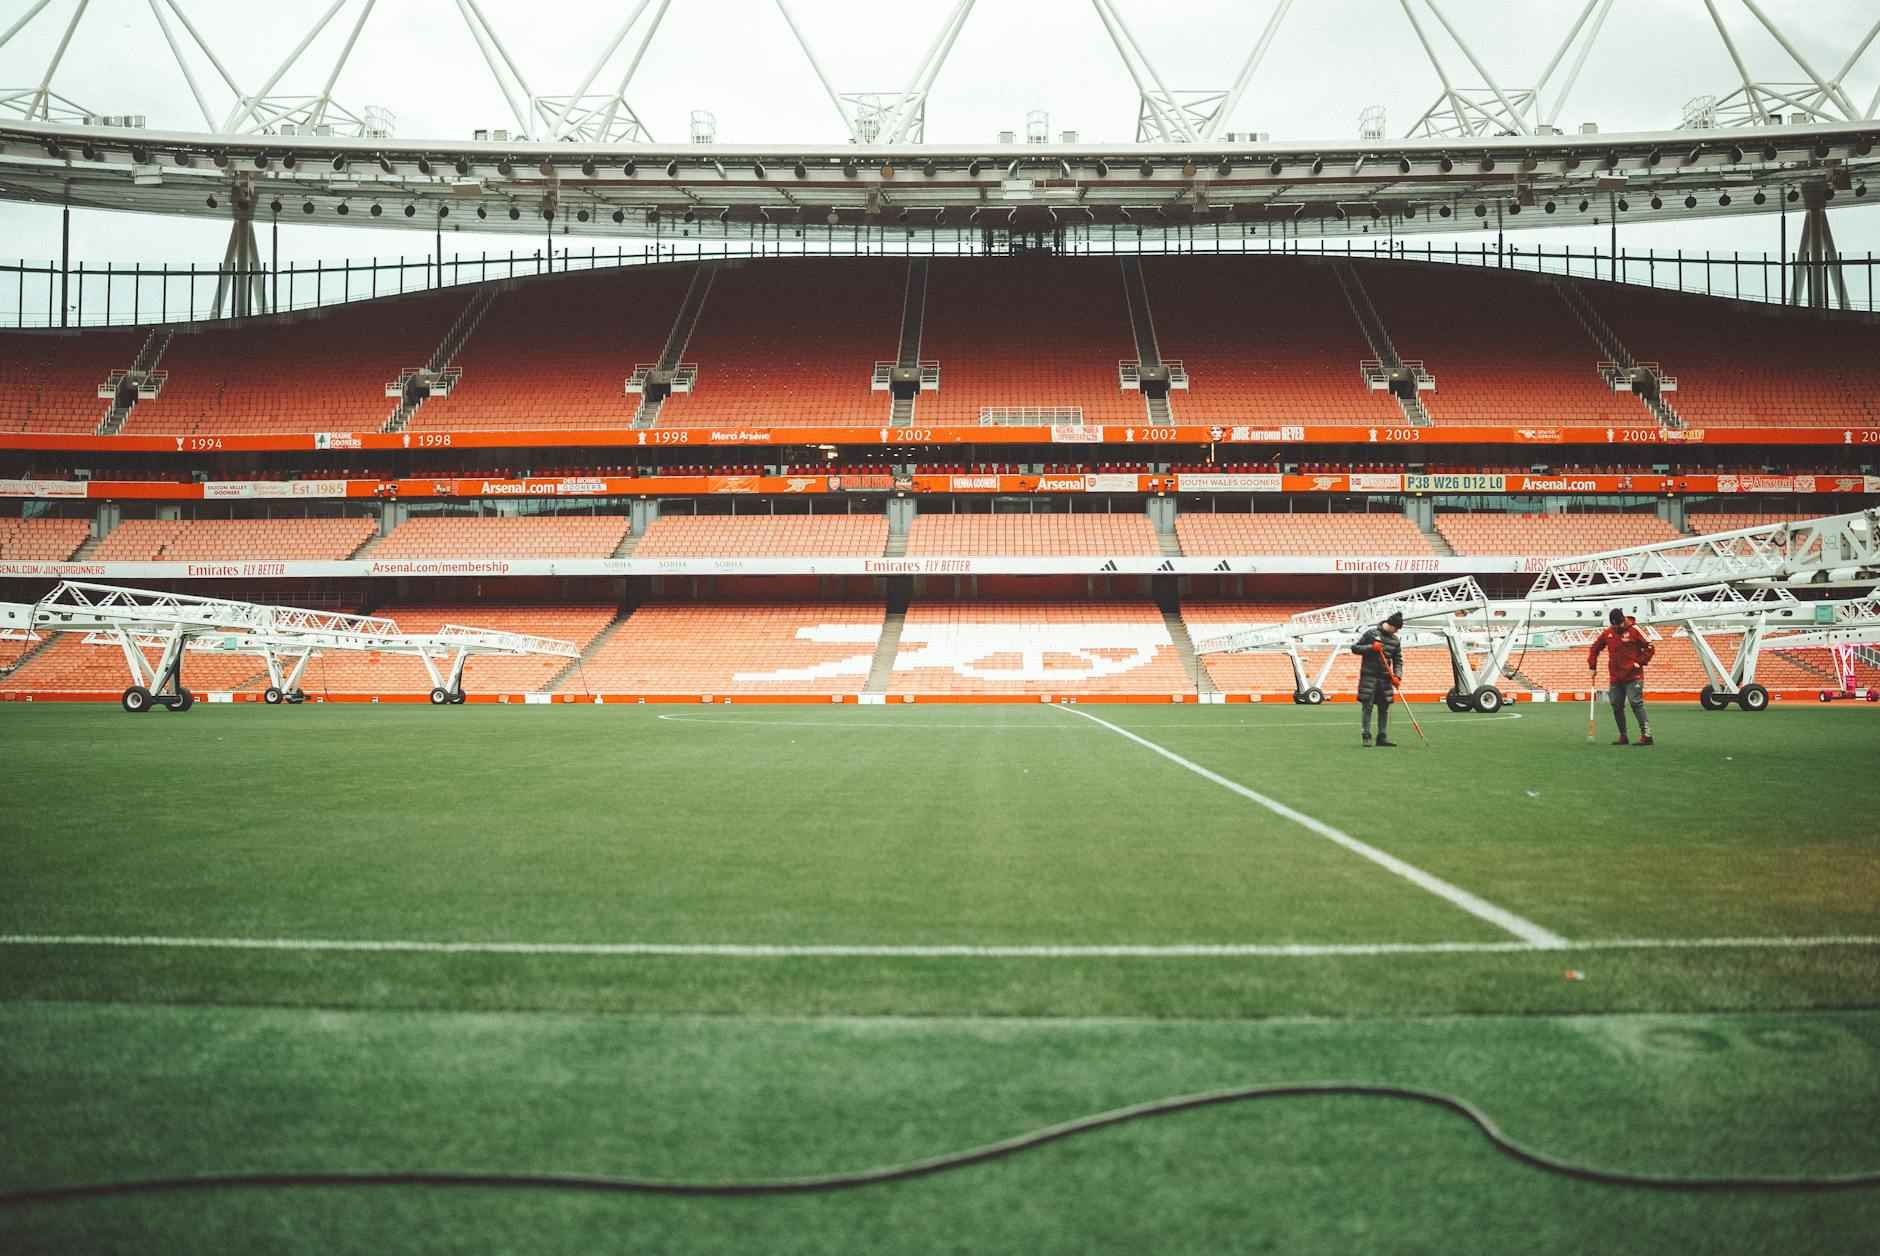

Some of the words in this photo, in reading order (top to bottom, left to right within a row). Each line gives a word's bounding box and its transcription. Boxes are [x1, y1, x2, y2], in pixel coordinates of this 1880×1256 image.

[418, 434, 452, 447] 1998
[655, 431, 688, 443] 1998
[896, 429, 932, 441] 2002
[1142, 429, 1177, 440] 2002
[1384, 429, 1420, 441] 2003
[1623, 430, 1656, 441] 2004
[1862, 431, 1880, 442] 20
[191, 438, 223, 450] 1994
[316, 484, 344, 494] 1985
[480, 481, 555, 494] Arsenal.com
[1038, 477, 1084, 490] Arsenal
[1408, 477, 1429, 489] P38
[1434, 477, 1459, 489] W26
[1464, 477, 1486, 489] D12
[1522, 478, 1596, 490] Arsenal.com
[188, 564, 239, 576] Emirates
[243, 564, 256, 576] FLY
[257, 563, 286, 576] BETTER
[373, 562, 510, 575] Arsenal.com/membership
[864, 560, 920, 572] Emirates
[925, 560, 939, 572] FLY
[940, 560, 971, 572] BETTER
[1336, 560, 1391, 571] Emirates
[1394, 560, 1408, 571] FLY
[1411, 560, 1440, 571] BETTER
